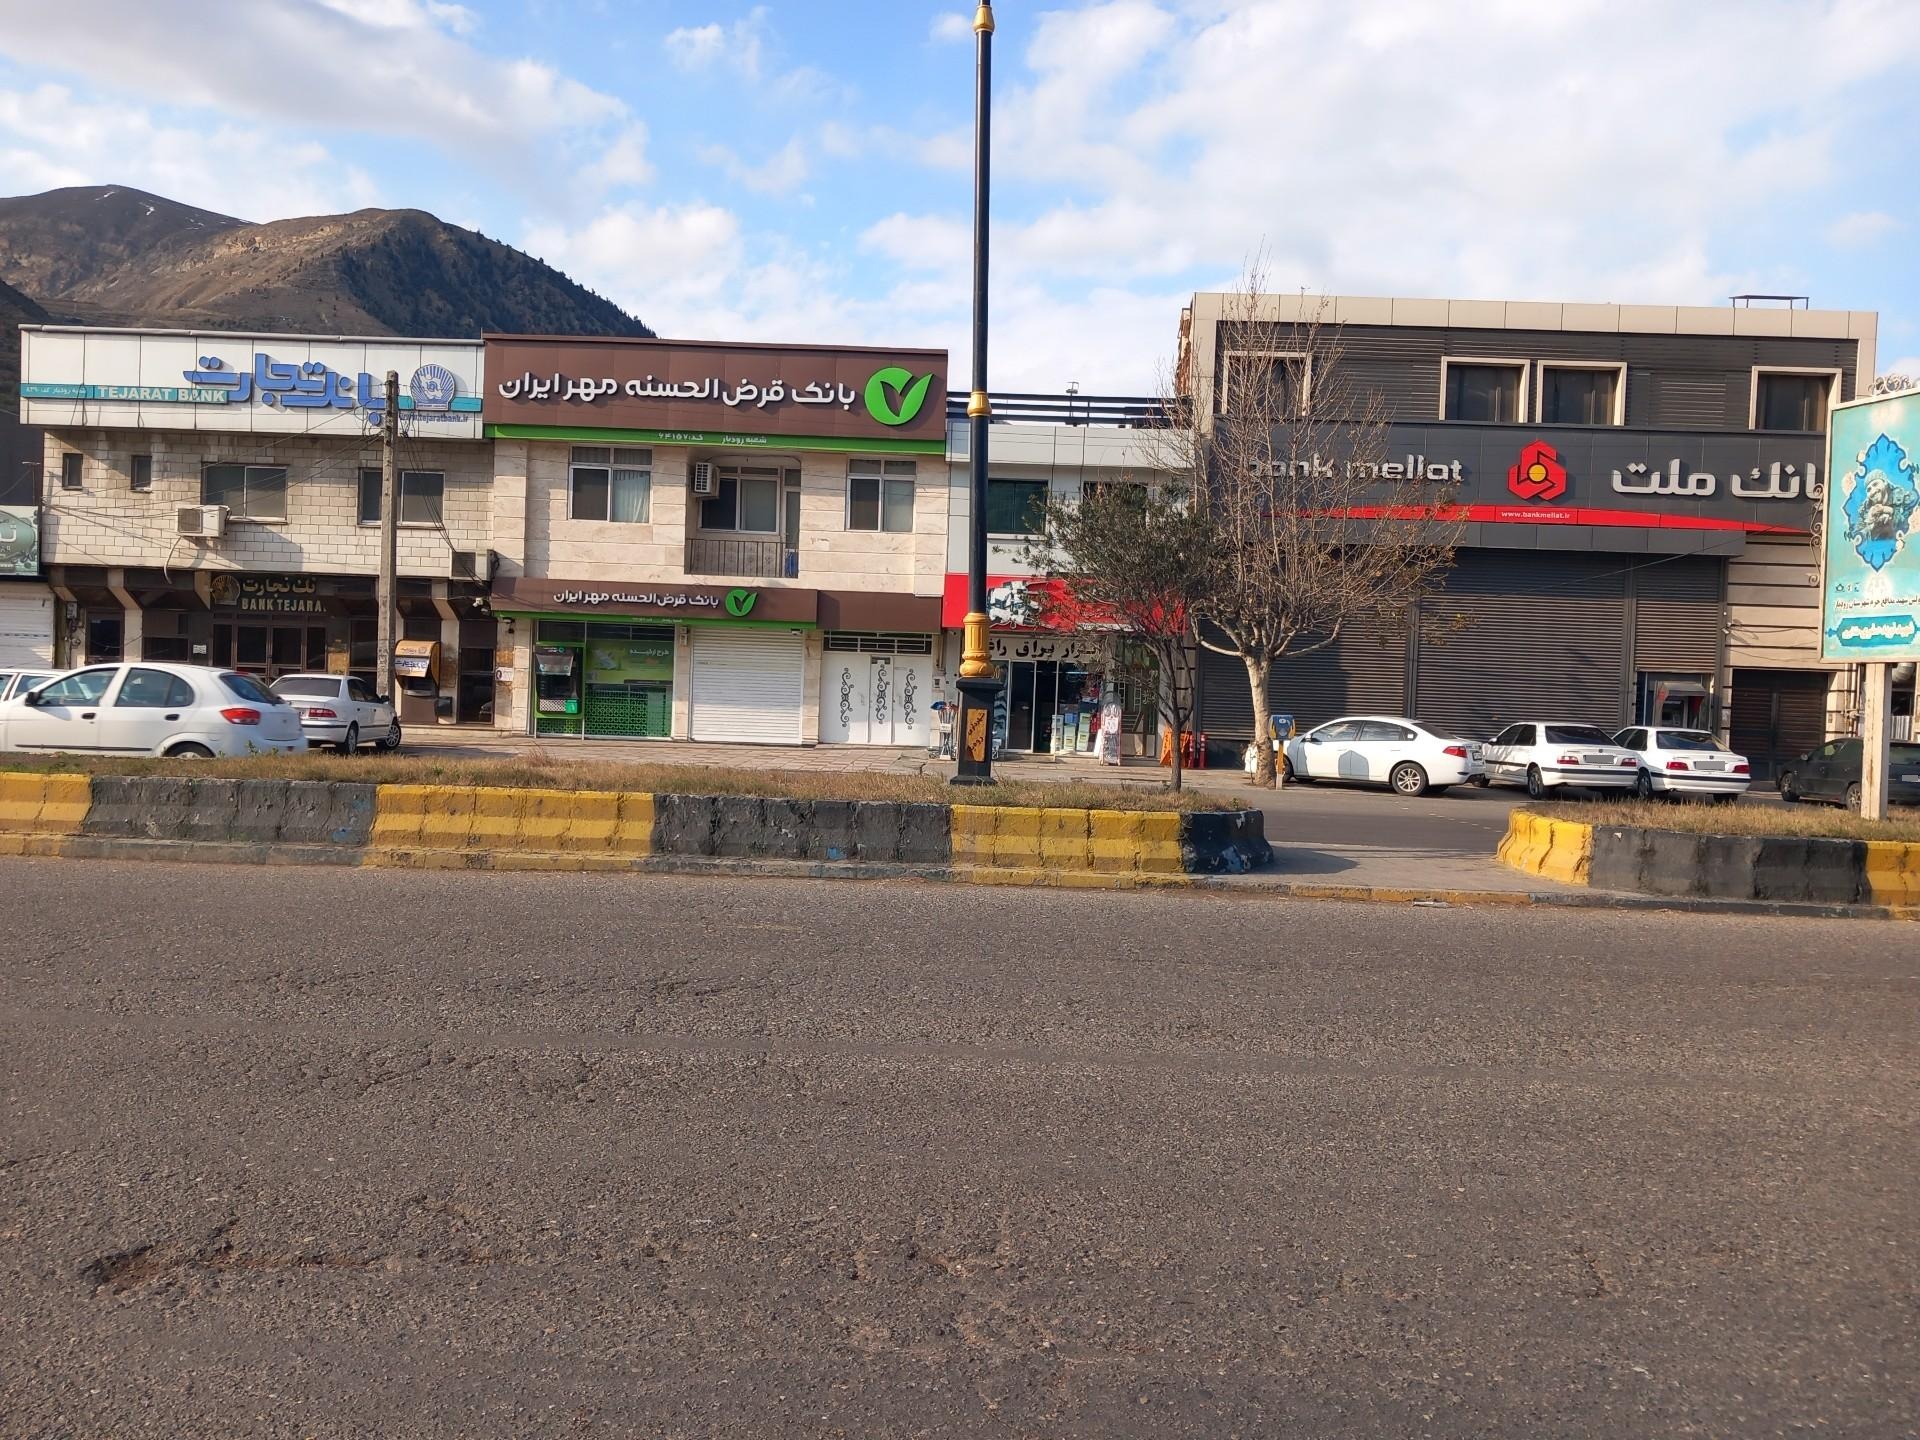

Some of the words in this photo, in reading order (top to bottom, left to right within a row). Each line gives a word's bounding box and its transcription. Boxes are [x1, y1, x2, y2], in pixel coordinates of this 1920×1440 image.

[183, 353, 325, 406] تجارت
[499, 371, 560, 399] ایران
[625, 374, 719, 399] الحسنه
[98, 386, 172, 401] TEJARAT
[178, 389, 224, 402] BANK
[563, 377, 617, 402] مهر
[722, 378, 785, 408] قرض
[792, 380, 855, 410] بانک
[721, 434, 745, 447] رودبار
[746, 435, 767, 445] شعبه
[1346, 454, 1463, 481] mellat
[1612, 458, 1716, 497] ملت
[1501, 511, 1570, 520] www.bankmellat.ir
[553, 589, 583, 603] ایران
[583, 591, 610, 605] مهر
[612, 592, 656, 604] الحسنه
[657, 593, 687, 608] قرض
[689, 594, 719, 609] بانک
[241, 598, 274, 610] BANK
